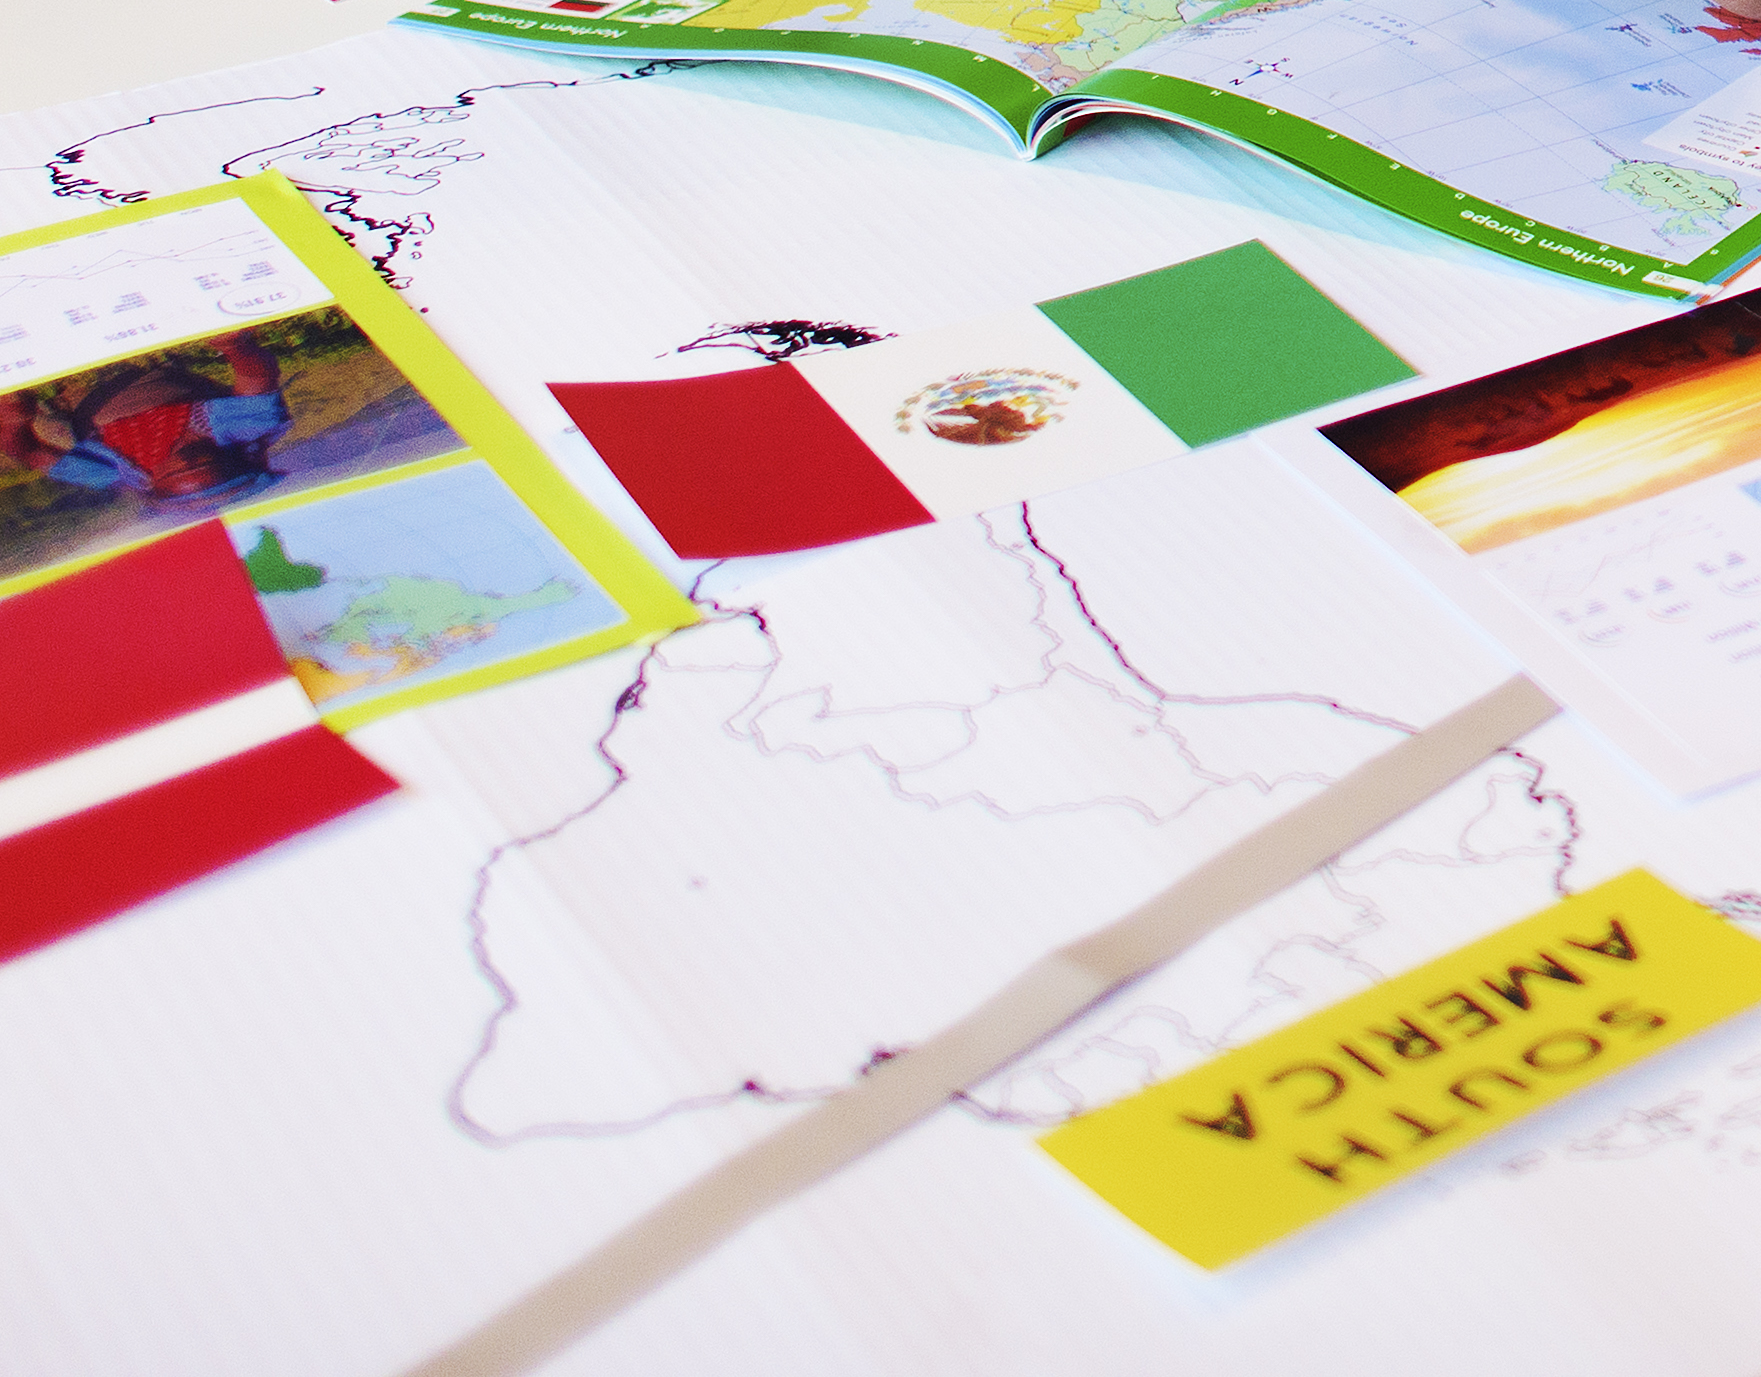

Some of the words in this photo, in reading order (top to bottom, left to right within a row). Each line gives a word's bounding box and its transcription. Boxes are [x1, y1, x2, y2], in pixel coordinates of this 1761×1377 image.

[467, 11, 538, 30] Europe
[539, 21, 629, 40] Northern
[1676, 141, 1732, 162] symbols
[1730, 158, 1747, 168] to
[1458, 208, 1535, 246] Europe
[1537, 238, 1636, 278] Northern
[1176, 916, 1639, 1143] AMERICA
[1293, 1002, 1668, 1186] SOUTH
